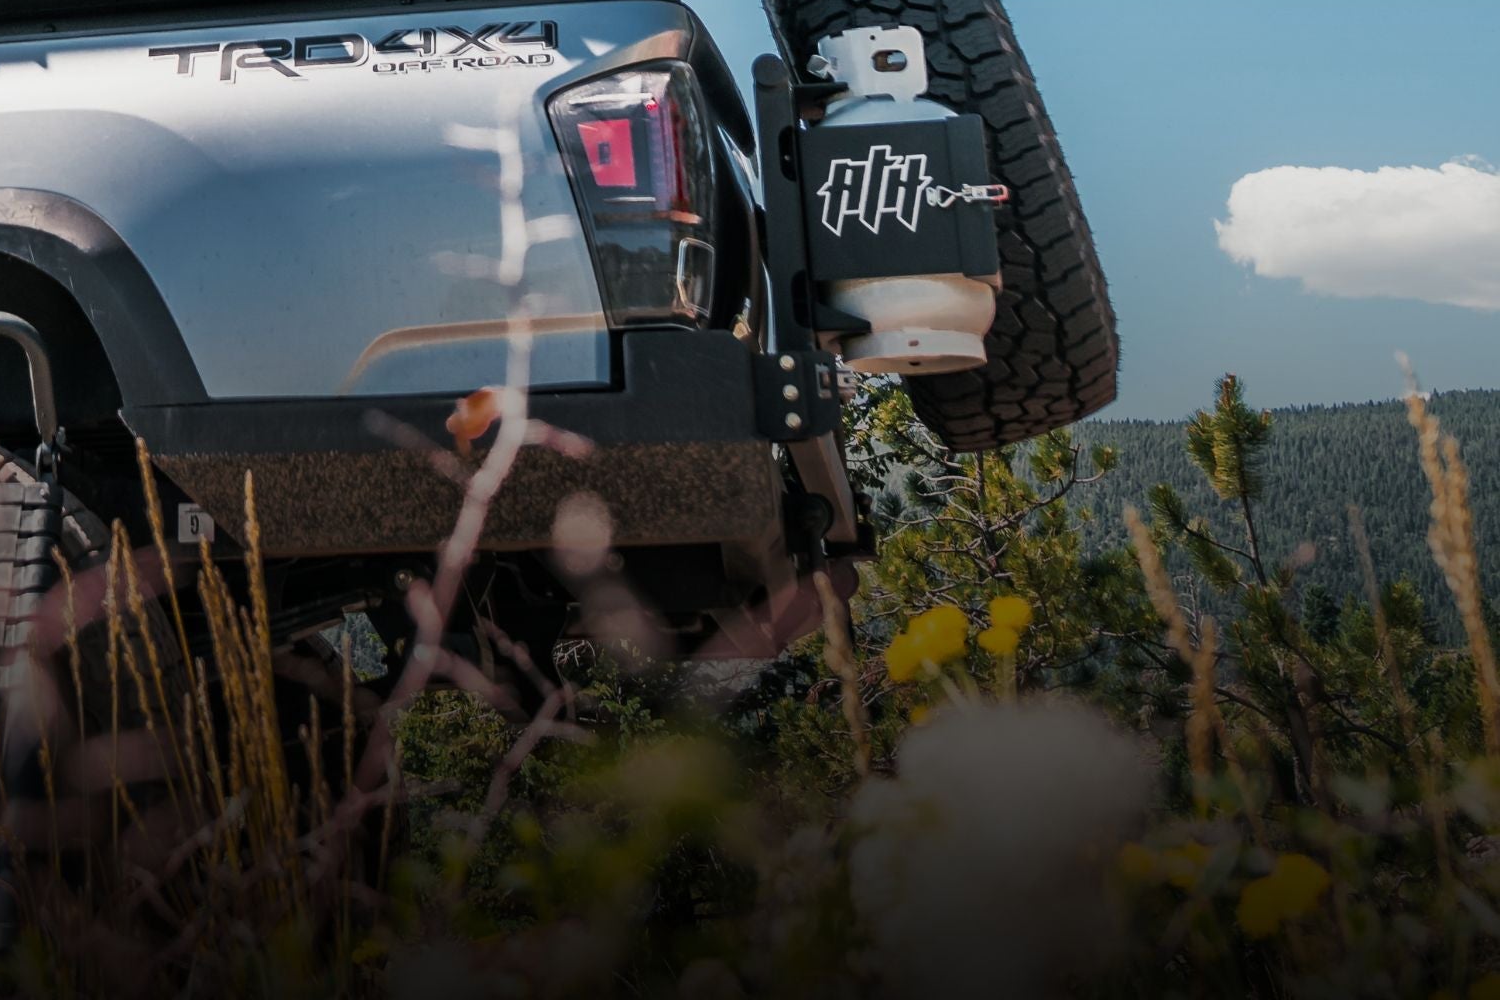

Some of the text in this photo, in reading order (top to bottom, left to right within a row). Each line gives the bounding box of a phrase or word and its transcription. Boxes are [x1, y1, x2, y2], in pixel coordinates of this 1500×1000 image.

[148, 32, 375, 84] TRD
[372, 50, 556, 76] OFF ROAD
